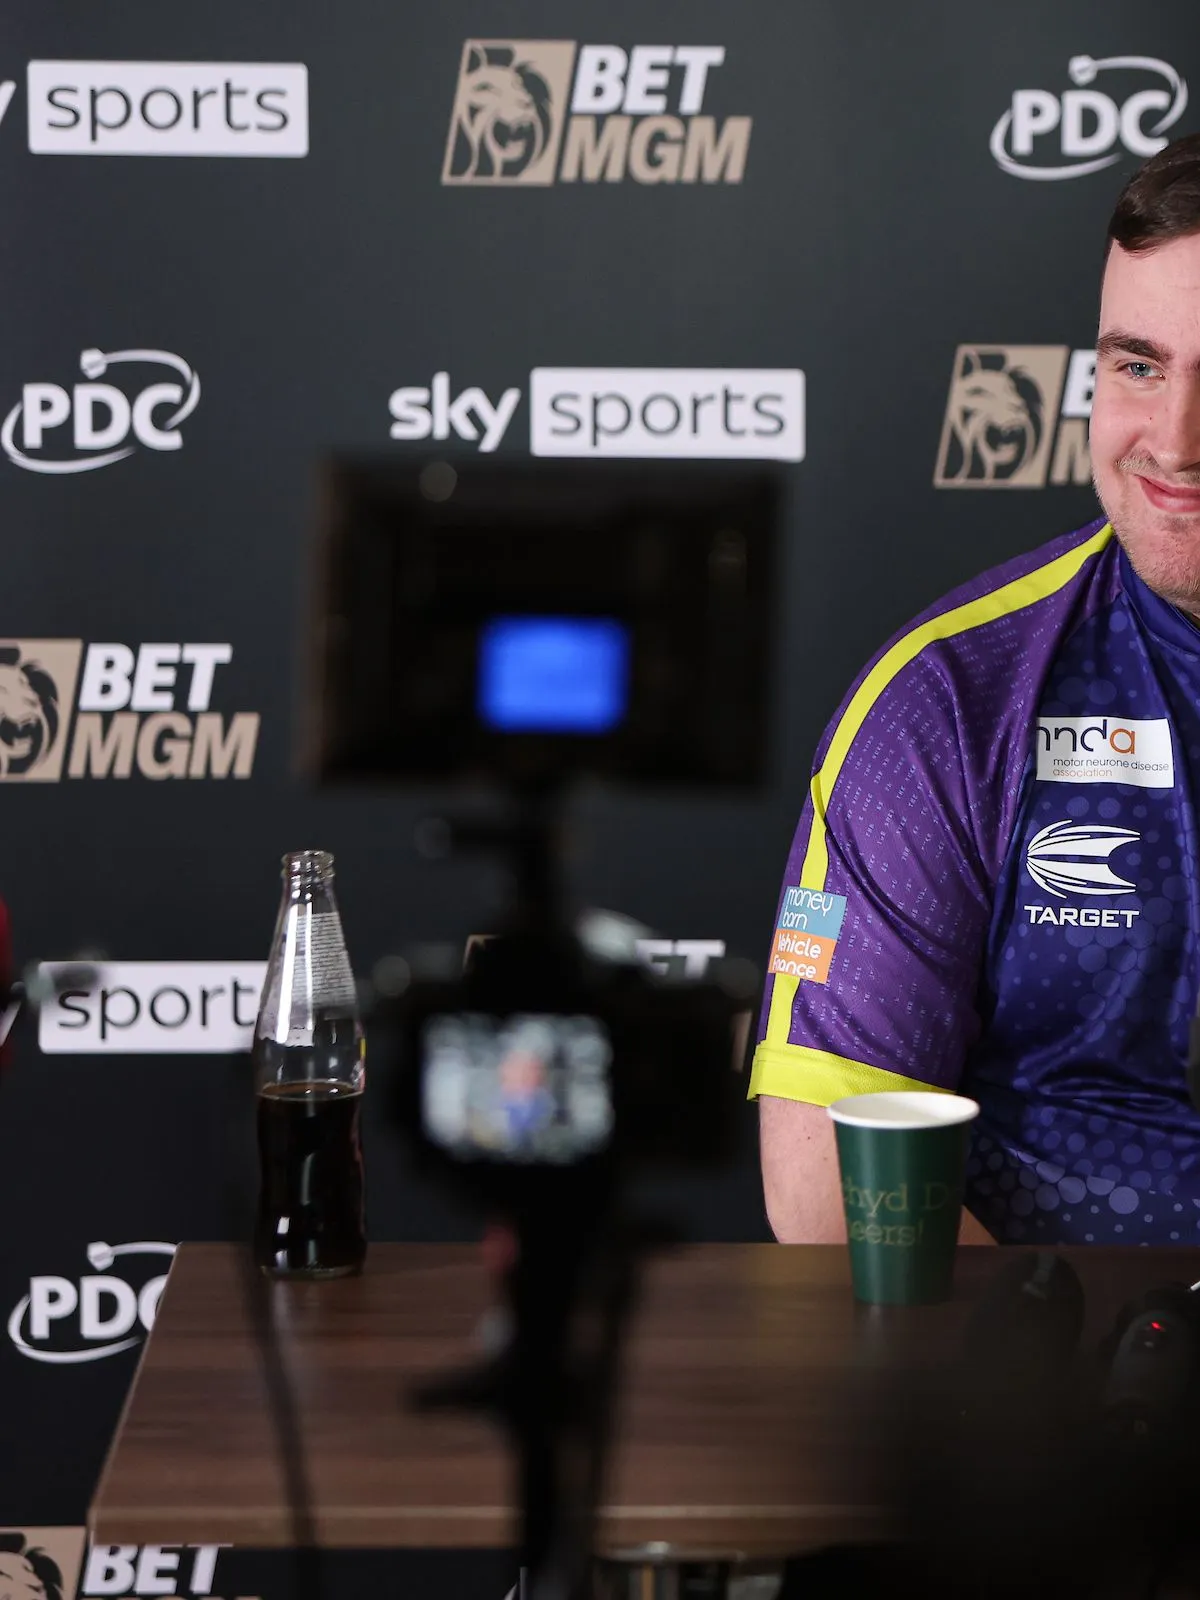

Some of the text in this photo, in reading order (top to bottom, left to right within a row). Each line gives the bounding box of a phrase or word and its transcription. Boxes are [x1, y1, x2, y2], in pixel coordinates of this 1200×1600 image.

[46, 80, 290, 143] sports
[573, 45, 725, 116] BET
[559, 115, 752, 184] MGM
[1011, 89, 1171, 157] PDC
[22, 383, 183, 451] PDC
[388, 370, 786, 453] sky sports
[79, 643, 233, 711] BET
[67, 712, 260, 779] MGM
[1052, 767, 1113, 778] association
[1053, 757, 1169, 772] motor neurone disease
[788, 888, 833, 917] money
[1023, 905, 1140, 928] TARGET
[57, 976, 258, 1041] sport
[82, 1545, 233, 1595] BET
